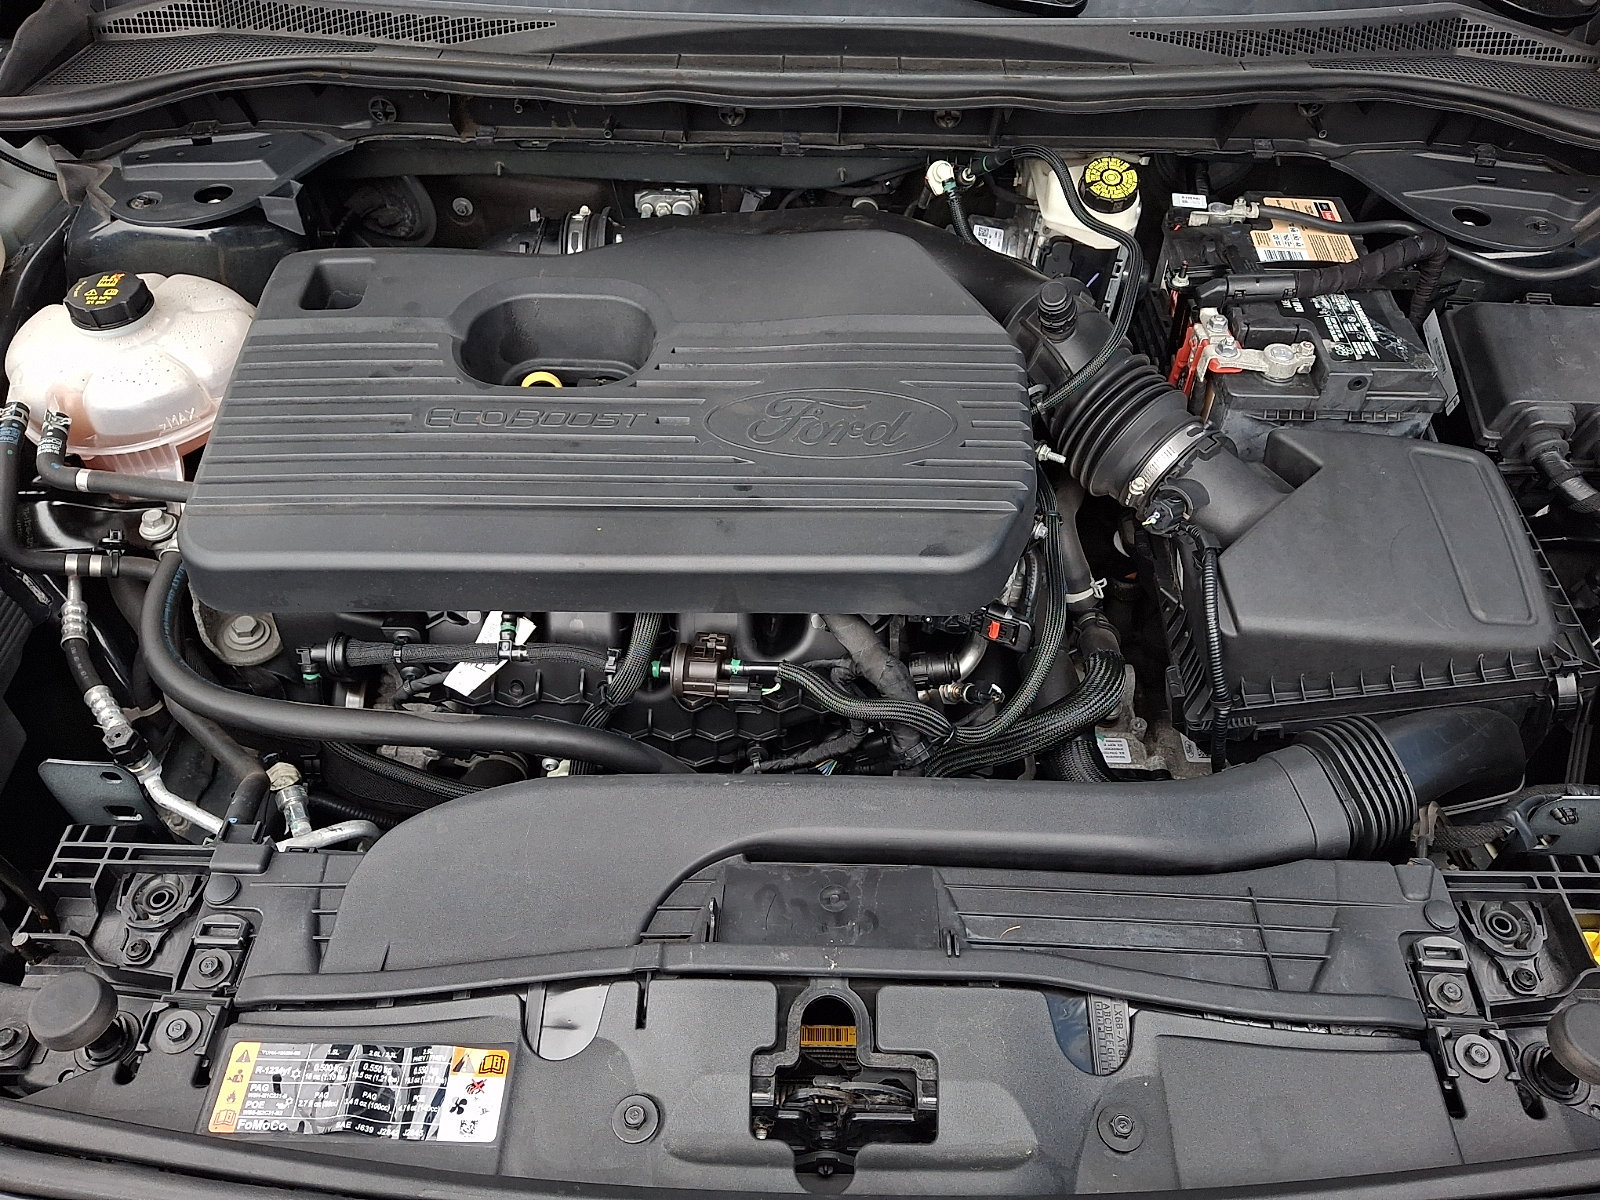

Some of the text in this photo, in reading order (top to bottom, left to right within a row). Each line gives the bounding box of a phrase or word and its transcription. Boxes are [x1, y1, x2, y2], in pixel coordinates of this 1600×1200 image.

[747, 397, 911, 446] Ford
[363, 1063, 383, 1074] 0.550
[250, 1083, 269, 1092] PAG
[362, 1091, 378, 1100] PAG
[245, 1100, 265, 1109] POE
[237, 1119, 288, 1131] FoMoCo
[335, 1121, 353, 1129] SAE
[354, 1123, 375, 1133] J639
